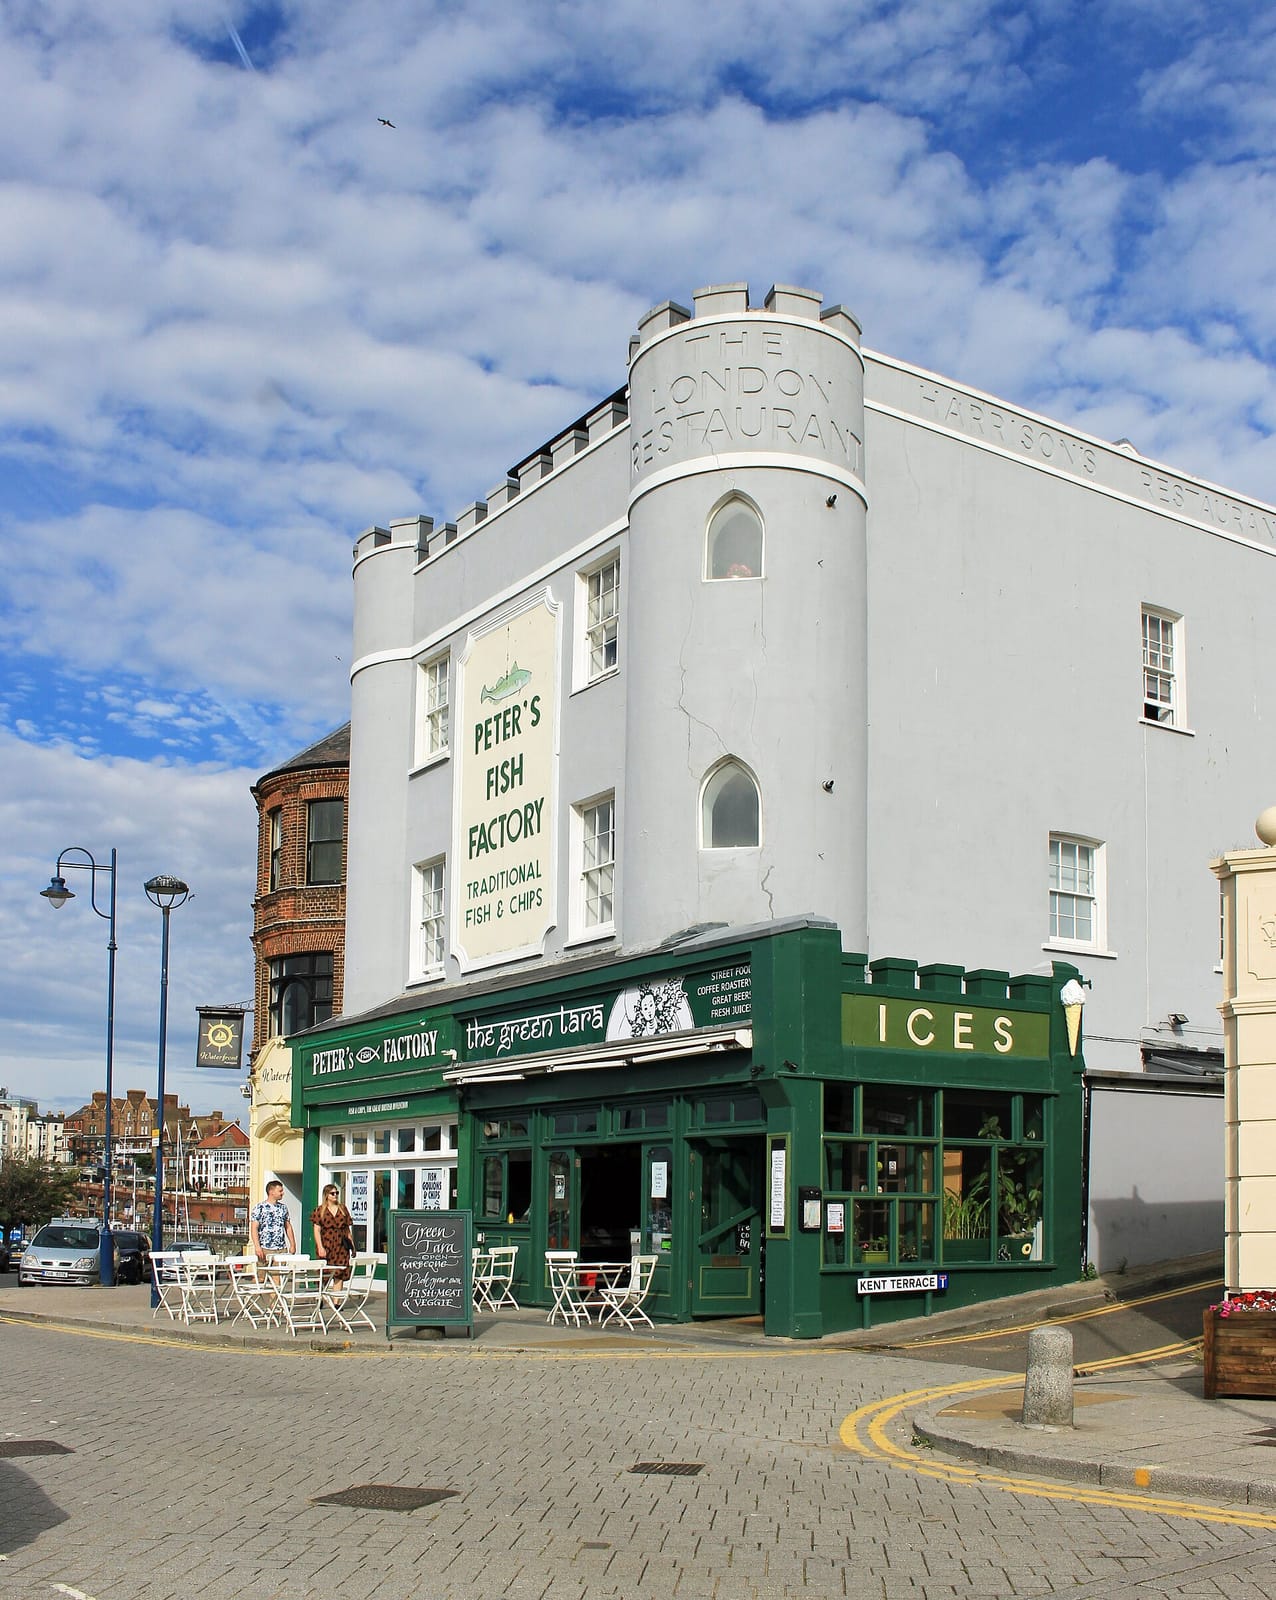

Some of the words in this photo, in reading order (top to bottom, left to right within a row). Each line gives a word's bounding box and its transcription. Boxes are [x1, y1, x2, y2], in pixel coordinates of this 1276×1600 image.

[685, 331, 782, 362] THE
[631, 406, 863, 475] RESTAURANT
[474, 694, 541, 755] PETER'S
[486, 752, 524, 800] FISH
[468, 797, 544, 859] FACTORY
[466, 858, 542, 899] TRADITIONAL
[465, 907, 491, 928] FISH
[497, 899, 504, 919] &
[510, 887, 543, 914] CHIPS
[697, 983, 720, 996] COFFEE
[711, 968, 734, 981] STREET
[710, 1007, 731, 1019] FRESH
[711, 994, 732, 1006] GREAT
[733, 991, 752, 1002] BEERS
[466, 1013, 496, 1050] the
[496, 1016, 553, 1056] green
[558, 1004, 604, 1035] tara
[878, 1004, 1014, 1053] ICES
[383, 1030, 439, 1064] FACTORY
[352, 1200, 368, 1212] £4.10
[401, 1221, 456, 1247] Green
[415, 1239, 461, 1256] Tara
[860, 1280, 887, 1291] KENT
[891, 1277, 935, 1289] TERRACE
[414, 1298, 462, 1309] VEGGIE
